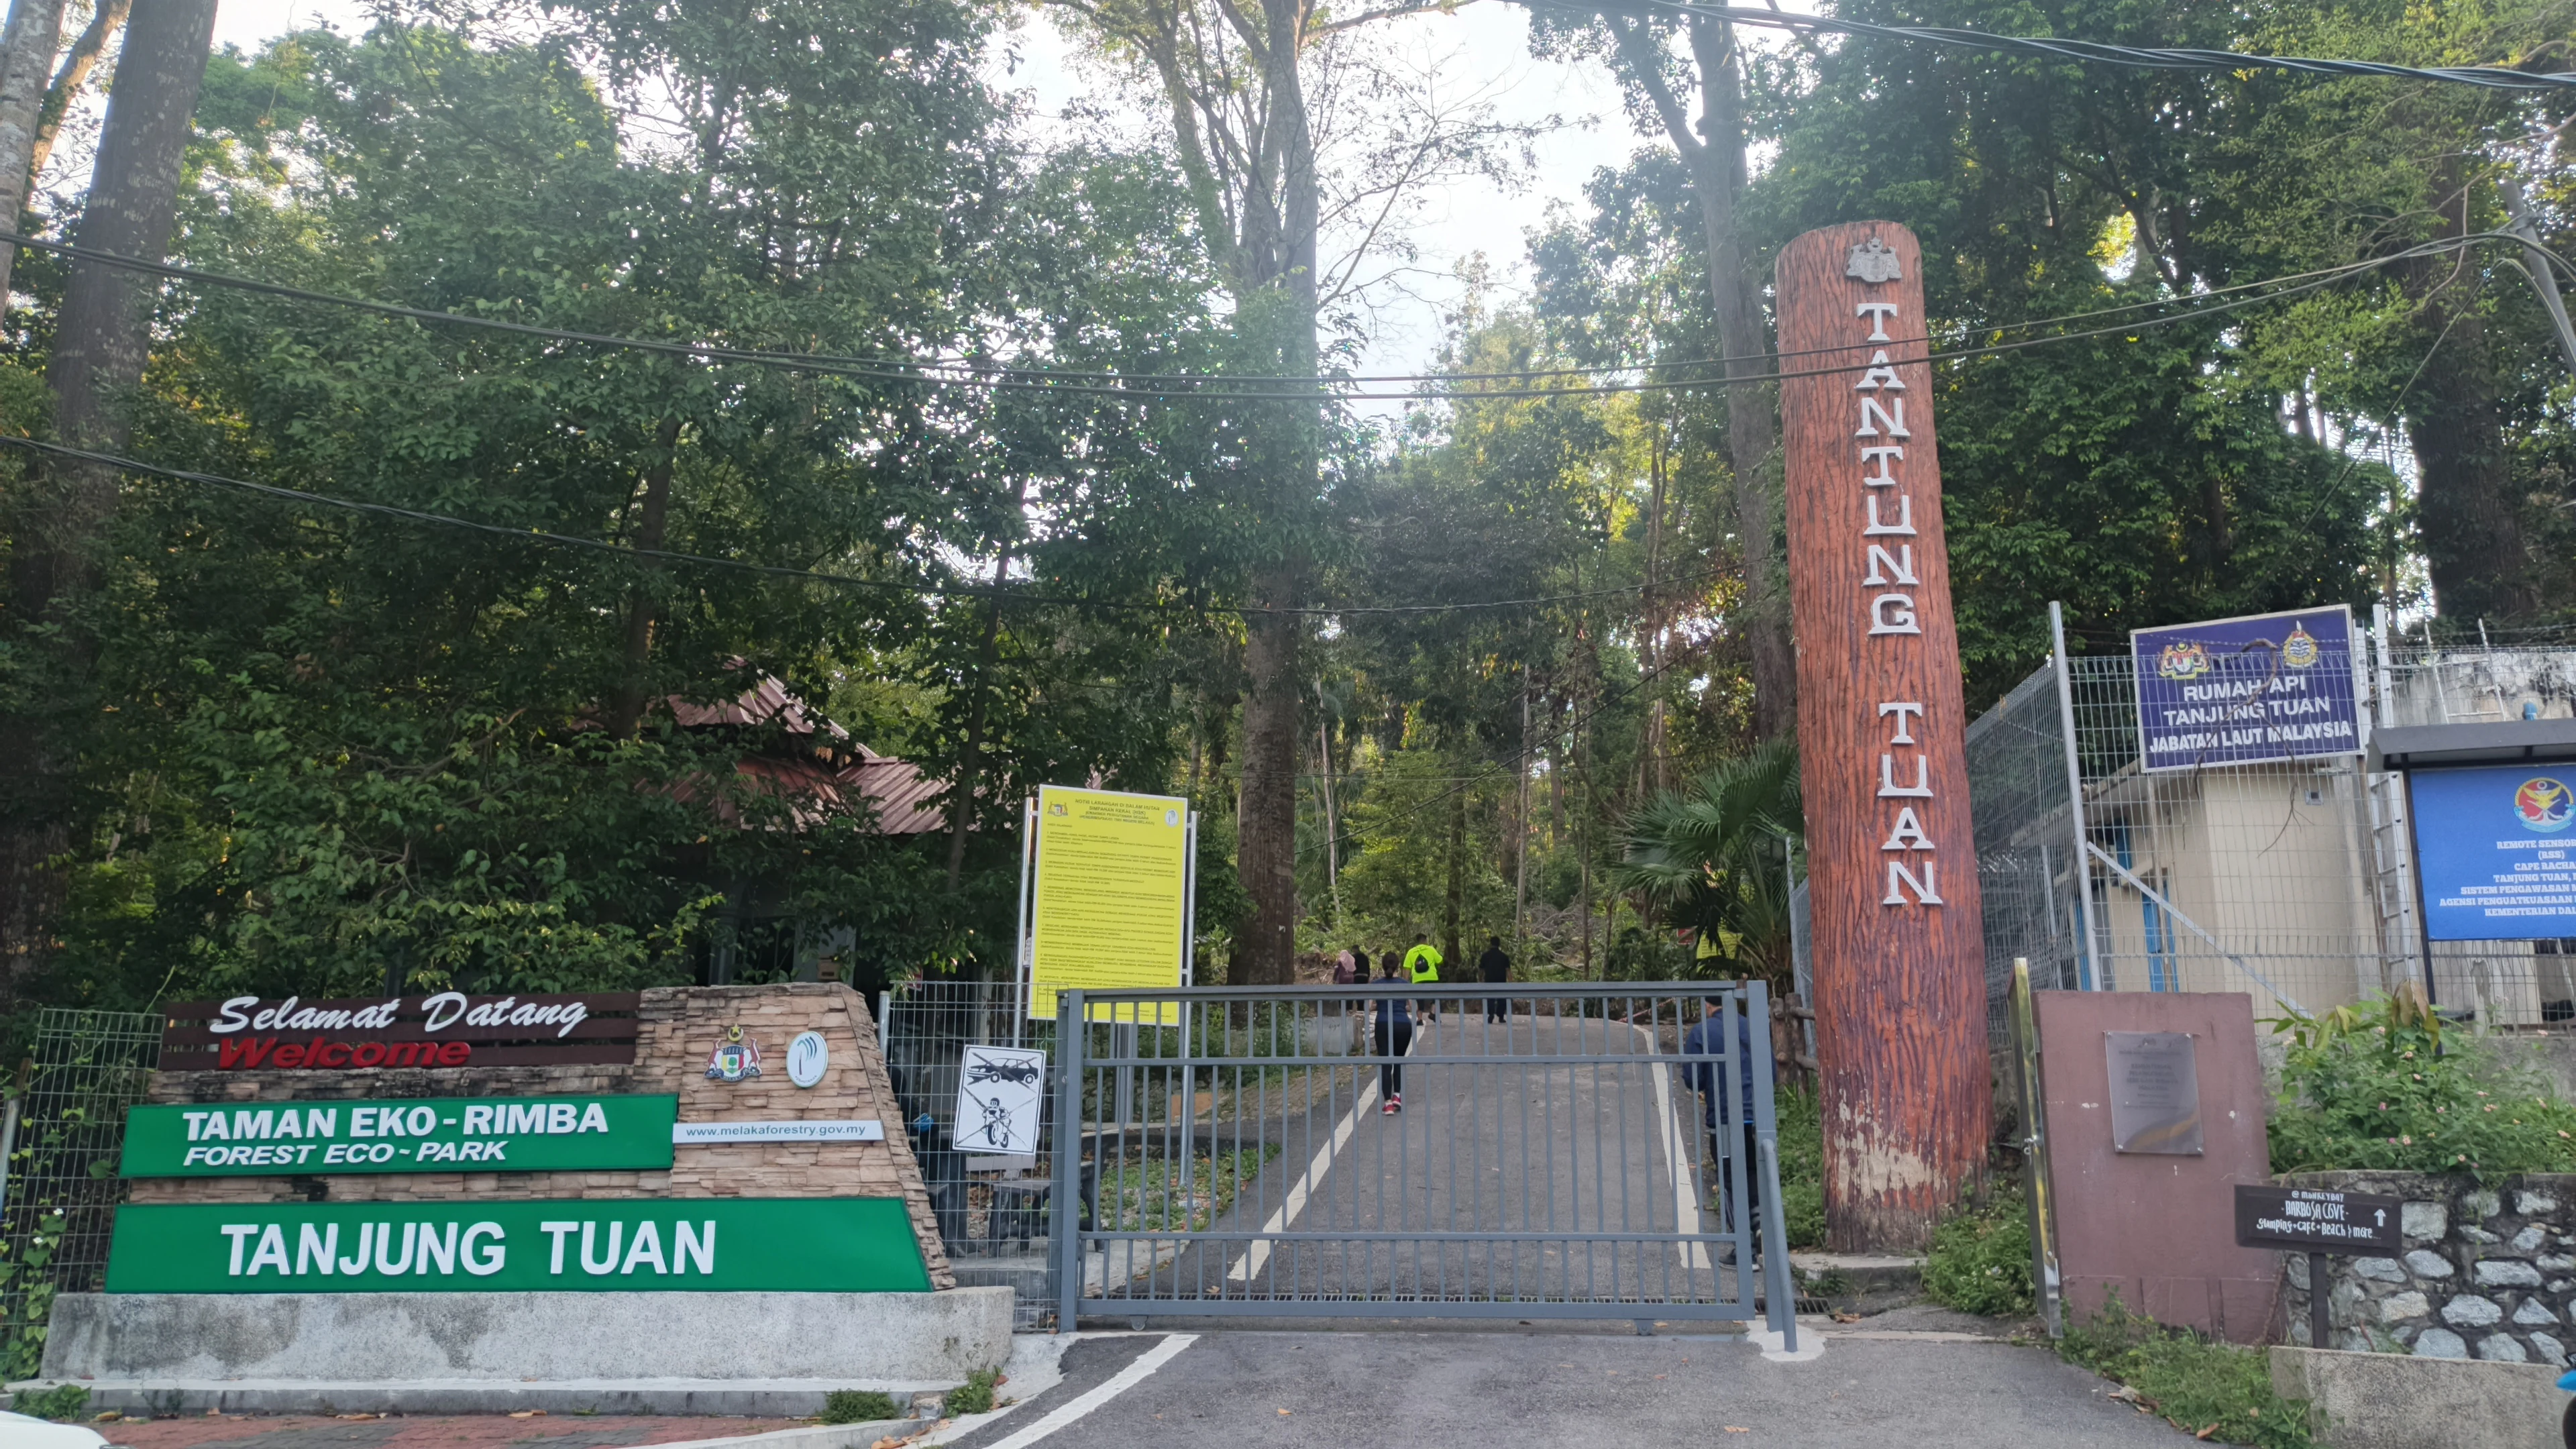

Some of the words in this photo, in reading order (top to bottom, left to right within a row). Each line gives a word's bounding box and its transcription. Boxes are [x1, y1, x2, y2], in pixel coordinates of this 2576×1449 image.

[2184, 678, 2262, 702] RUMAH
[2269, 675, 2306, 694] API
[2163, 702, 2265, 727] TANJUNG
[2268, 696, 2330, 716] TUAN
[2150, 732, 2218, 753] JABATAN
[2222, 727, 2263, 747] LAUT
[2267, 720, 2352, 743] MALAYSIA
[1877, 702, 1943, 905] TUAN
[2497, 841, 2536, 849] REMOTE
[2538, 850, 2565, 861] (RSS)
[2514, 863, 2540, 871] CAPE
[2541, 861, 2576, 871] RACHA
[2493, 874, 2539, 883] TANJUNG
[2540, 873, 2572, 882] TUAN,
[2439, 898, 2475, 906] AGENSI
[2477, 895, 2572, 906] PENGUATKUASAAN
[2461, 885, 2498, 895] SISTEM
[2499, 884, 2570, 894] PENGAWASAN
[2484, 907, 2557, 916] KEMENTERIAN
[210, 995, 401, 1034] Selamat
[421, 991, 589, 1038] Datang
[219, 1036, 472, 1069] Welcome
[182, 1108, 337, 1141] TAMAN
[350, 1106, 436, 1137] EKO
[462, 1102, 609, 1135] RIMBA
[686, 1124, 866, 1137] www.melakaforestry.gov.my
[182, 1144, 317, 1166] FOREST
[323, 1142, 395, 1164] ECO
[415, 1140, 509, 1162] PARK
[2322, 1203, 2345, 1221] COVE
[220, 1222, 506, 1276] TANJUNG
[540, 1220, 716, 1275] TUAN
